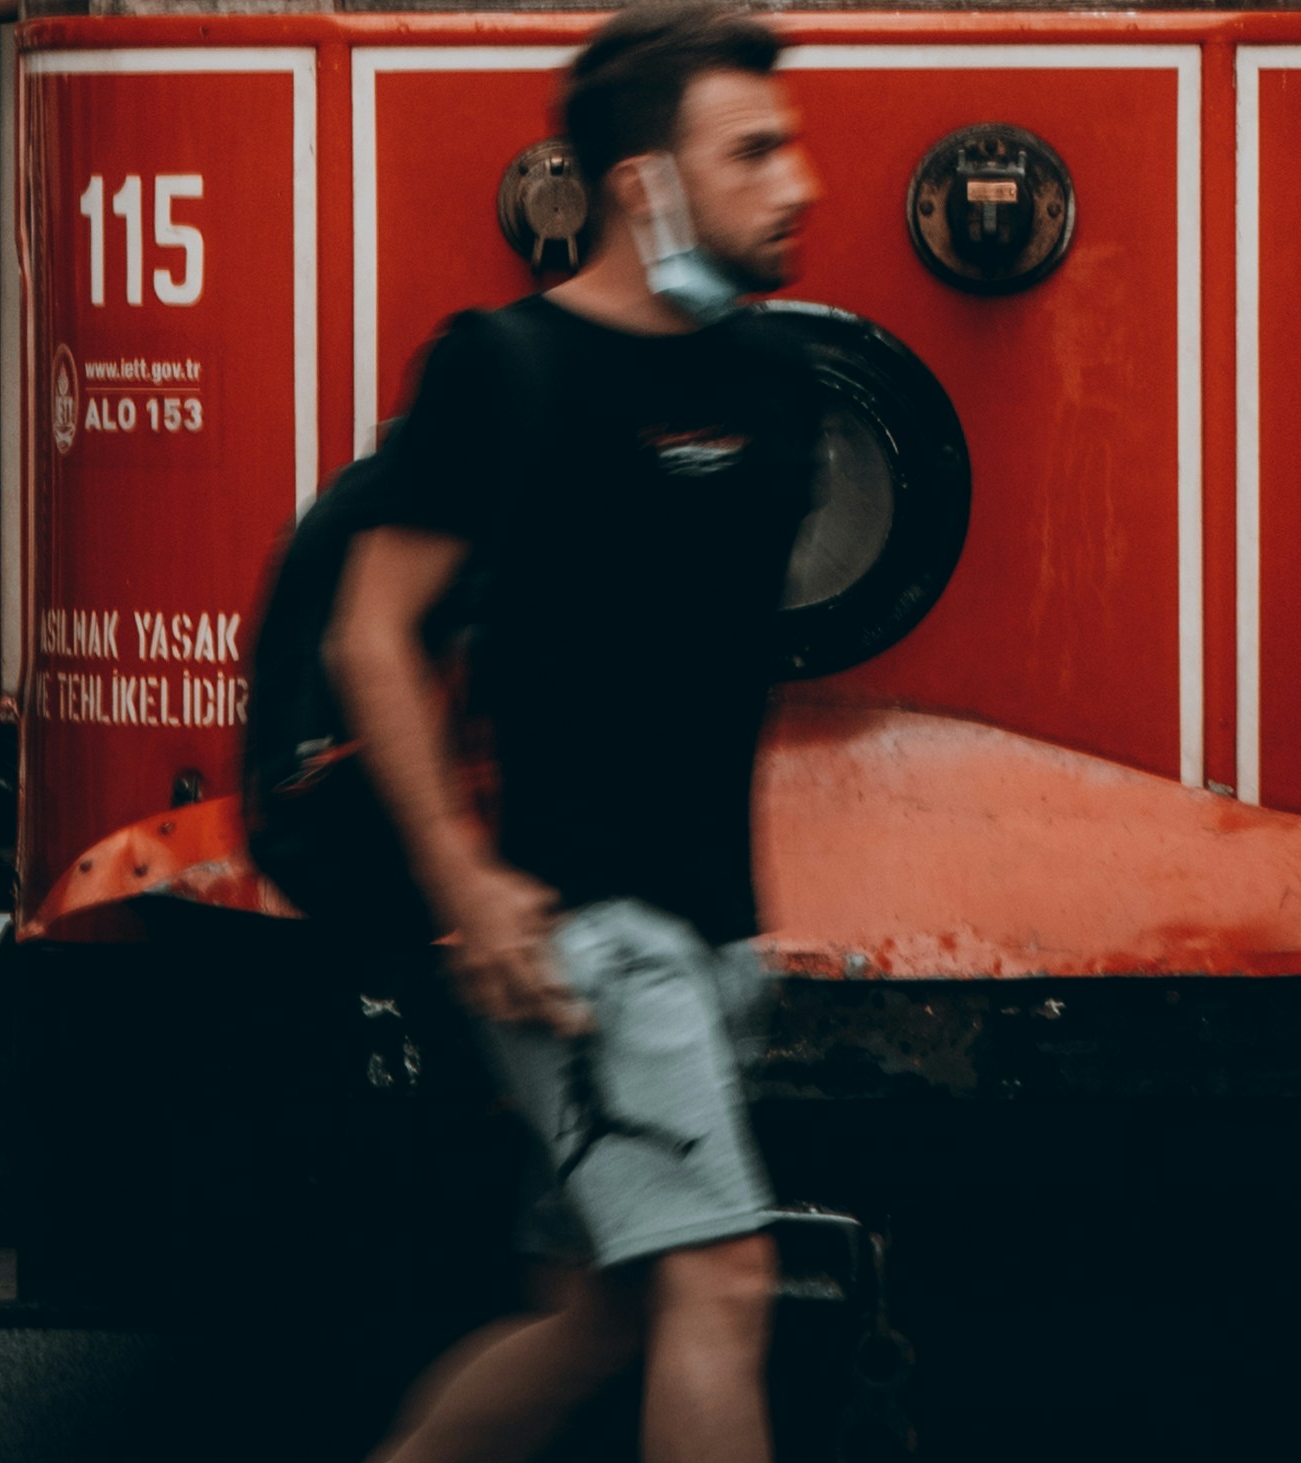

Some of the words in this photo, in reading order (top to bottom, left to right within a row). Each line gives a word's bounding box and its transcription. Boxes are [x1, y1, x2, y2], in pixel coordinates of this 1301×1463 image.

[80, 174, 205, 306] 115
[84, 397, 137, 431] ALO
[146, 398, 203, 432] 153
[40, 608, 119, 660] ASILMAK
[133, 610, 241, 662] YASAK
[57, 668, 249, 727] TEHLİKELİDİR
